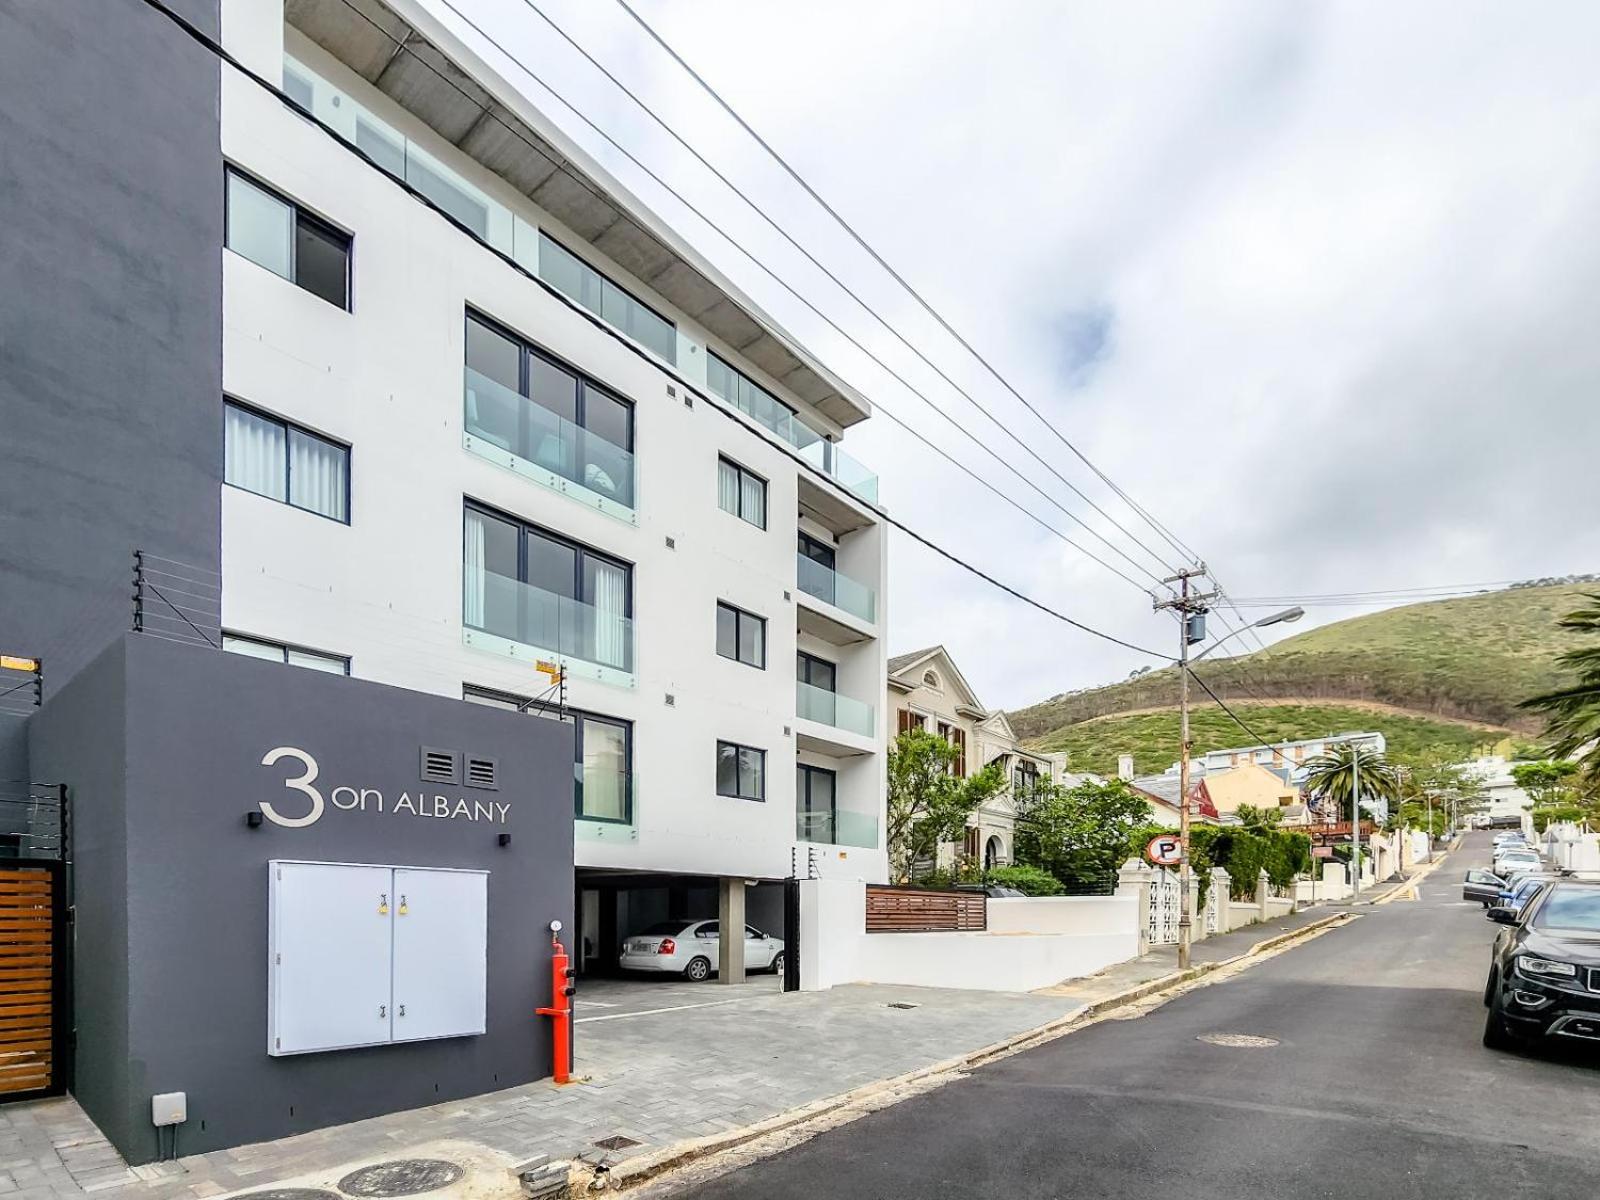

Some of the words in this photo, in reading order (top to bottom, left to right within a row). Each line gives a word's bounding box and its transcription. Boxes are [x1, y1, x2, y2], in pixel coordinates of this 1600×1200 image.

[259, 746, 325, 828] 3
[331, 786, 383, 812] on
[393, 792, 511, 823] ALBANY
[1159, 842, 1176, 858] P
